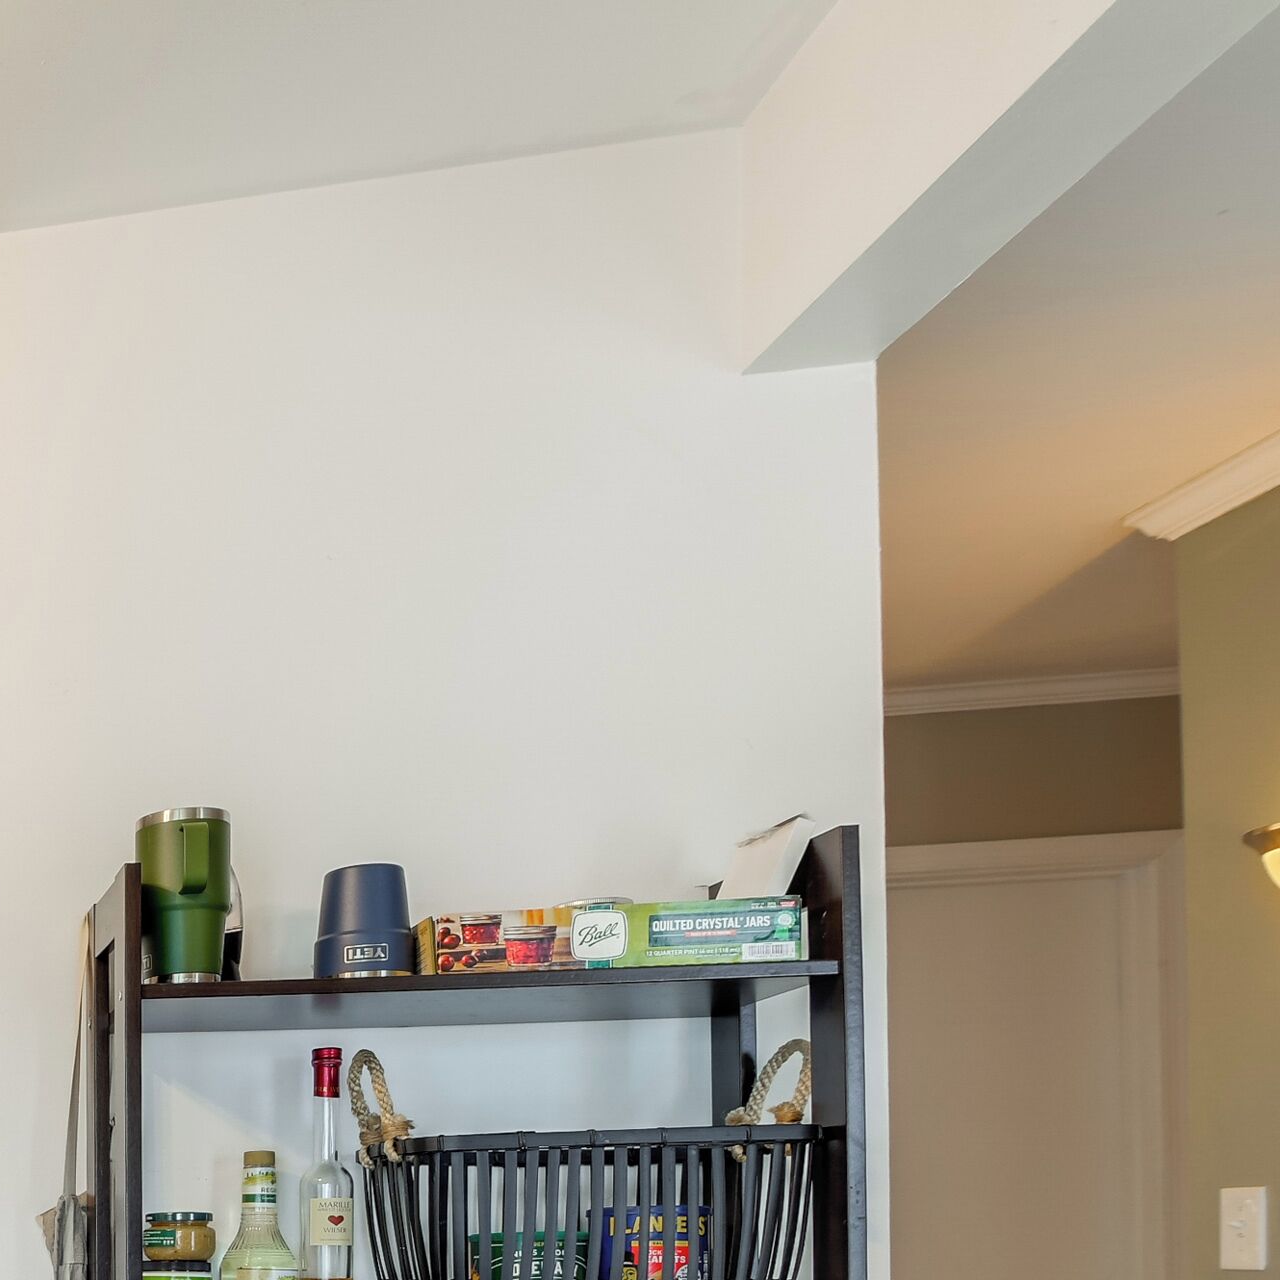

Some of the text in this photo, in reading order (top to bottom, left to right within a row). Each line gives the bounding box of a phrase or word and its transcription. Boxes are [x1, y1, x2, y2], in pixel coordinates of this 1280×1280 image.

[652, 916, 770, 932] QUILTED CRYSTAL JARS
[578, 922, 619, 946] Ball
[348, 946, 385, 960] YETI
